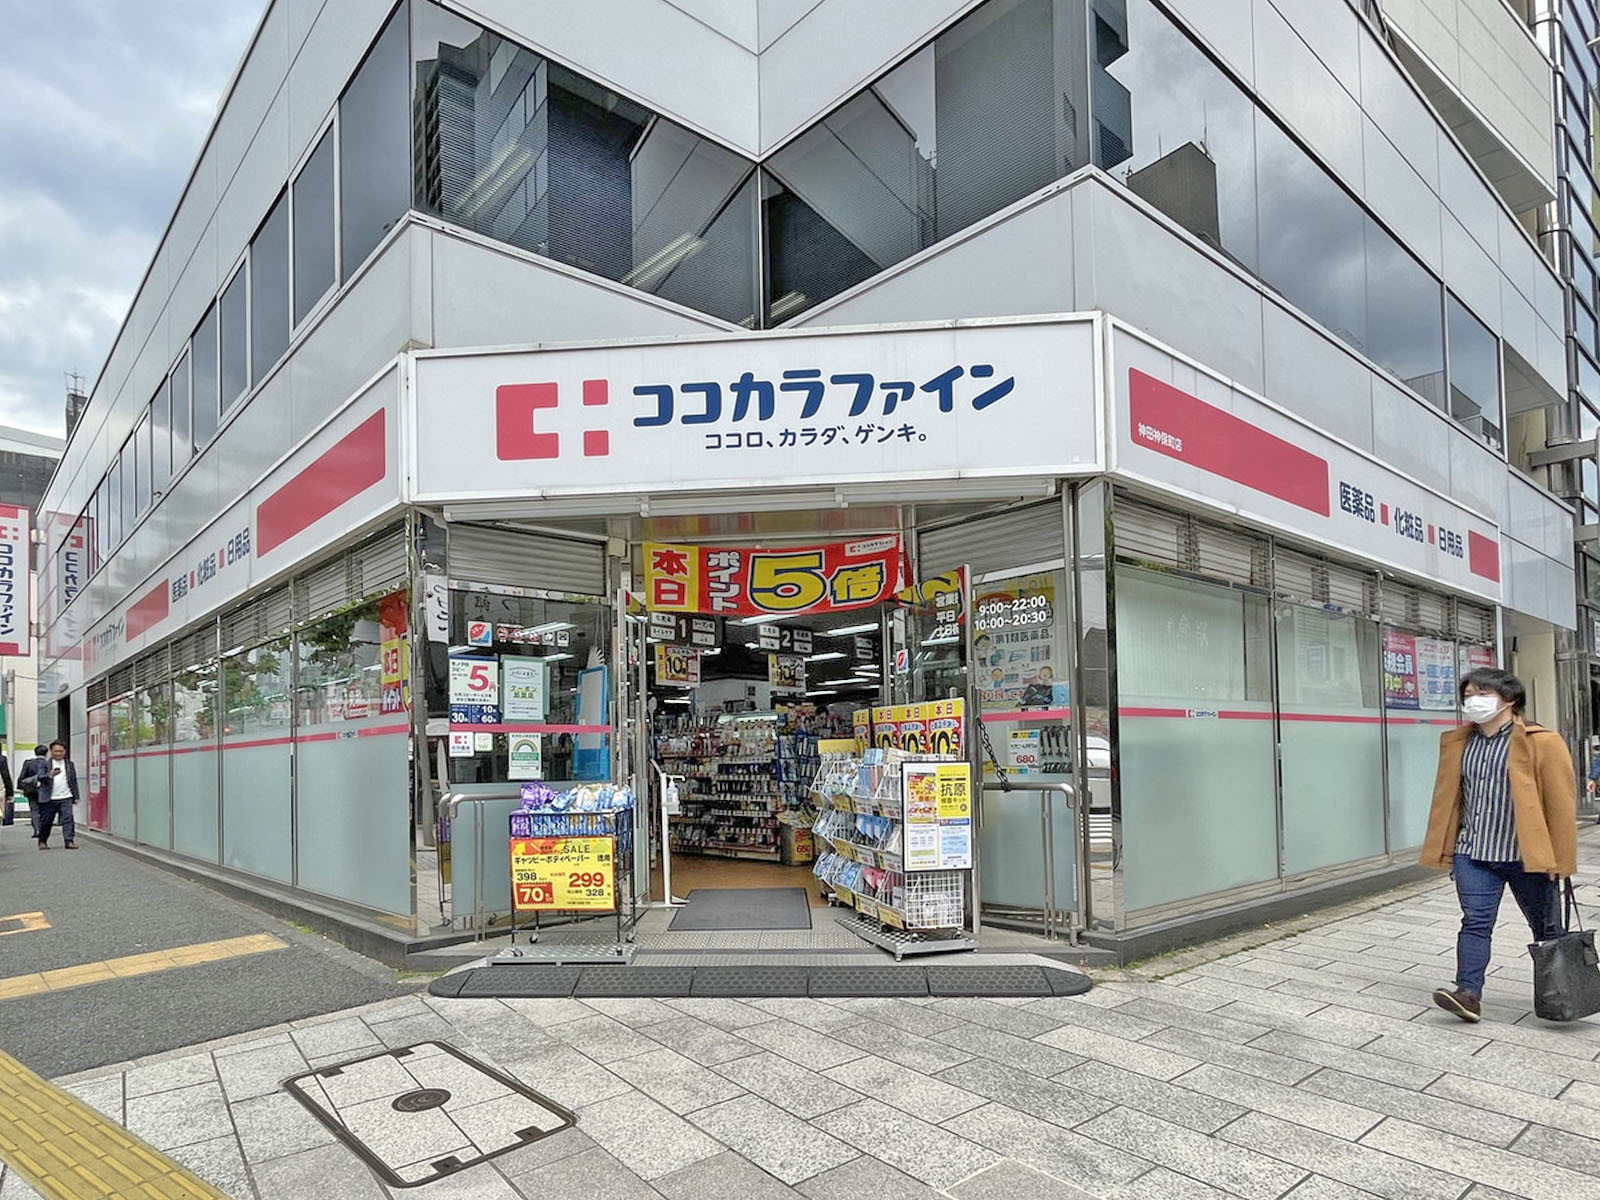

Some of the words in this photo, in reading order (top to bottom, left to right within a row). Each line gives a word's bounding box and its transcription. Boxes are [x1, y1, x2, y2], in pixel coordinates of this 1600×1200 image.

[633, 364, 1015, 428] ココカラファイン
[705, 424, 927, 450] ココロ、カラダ、ゲンキ。
[1138, 422, 1183, 453] 神田神保町店
[1339, 481, 1376, 524] 医薬品
[1394, 506, 1424, 544] 化粧品
[1438, 526, 1464, 559] 日用品
[227, 527, 250, 565] 日用品
[652, 550, 688, 606] 本日
[707, 550, 741, 611] ポイント
[936, 610, 955, 623] 平日
[781, 630, 791, 647] 2
[940, 782, 967, 797] 抗原
[563, 845, 590, 854] SALE
[516, 872, 538, 881] 398
[569, 872, 605, 888] 299
[520, 888, 544, 902] 70
[585, 889, 605, 897] 328
